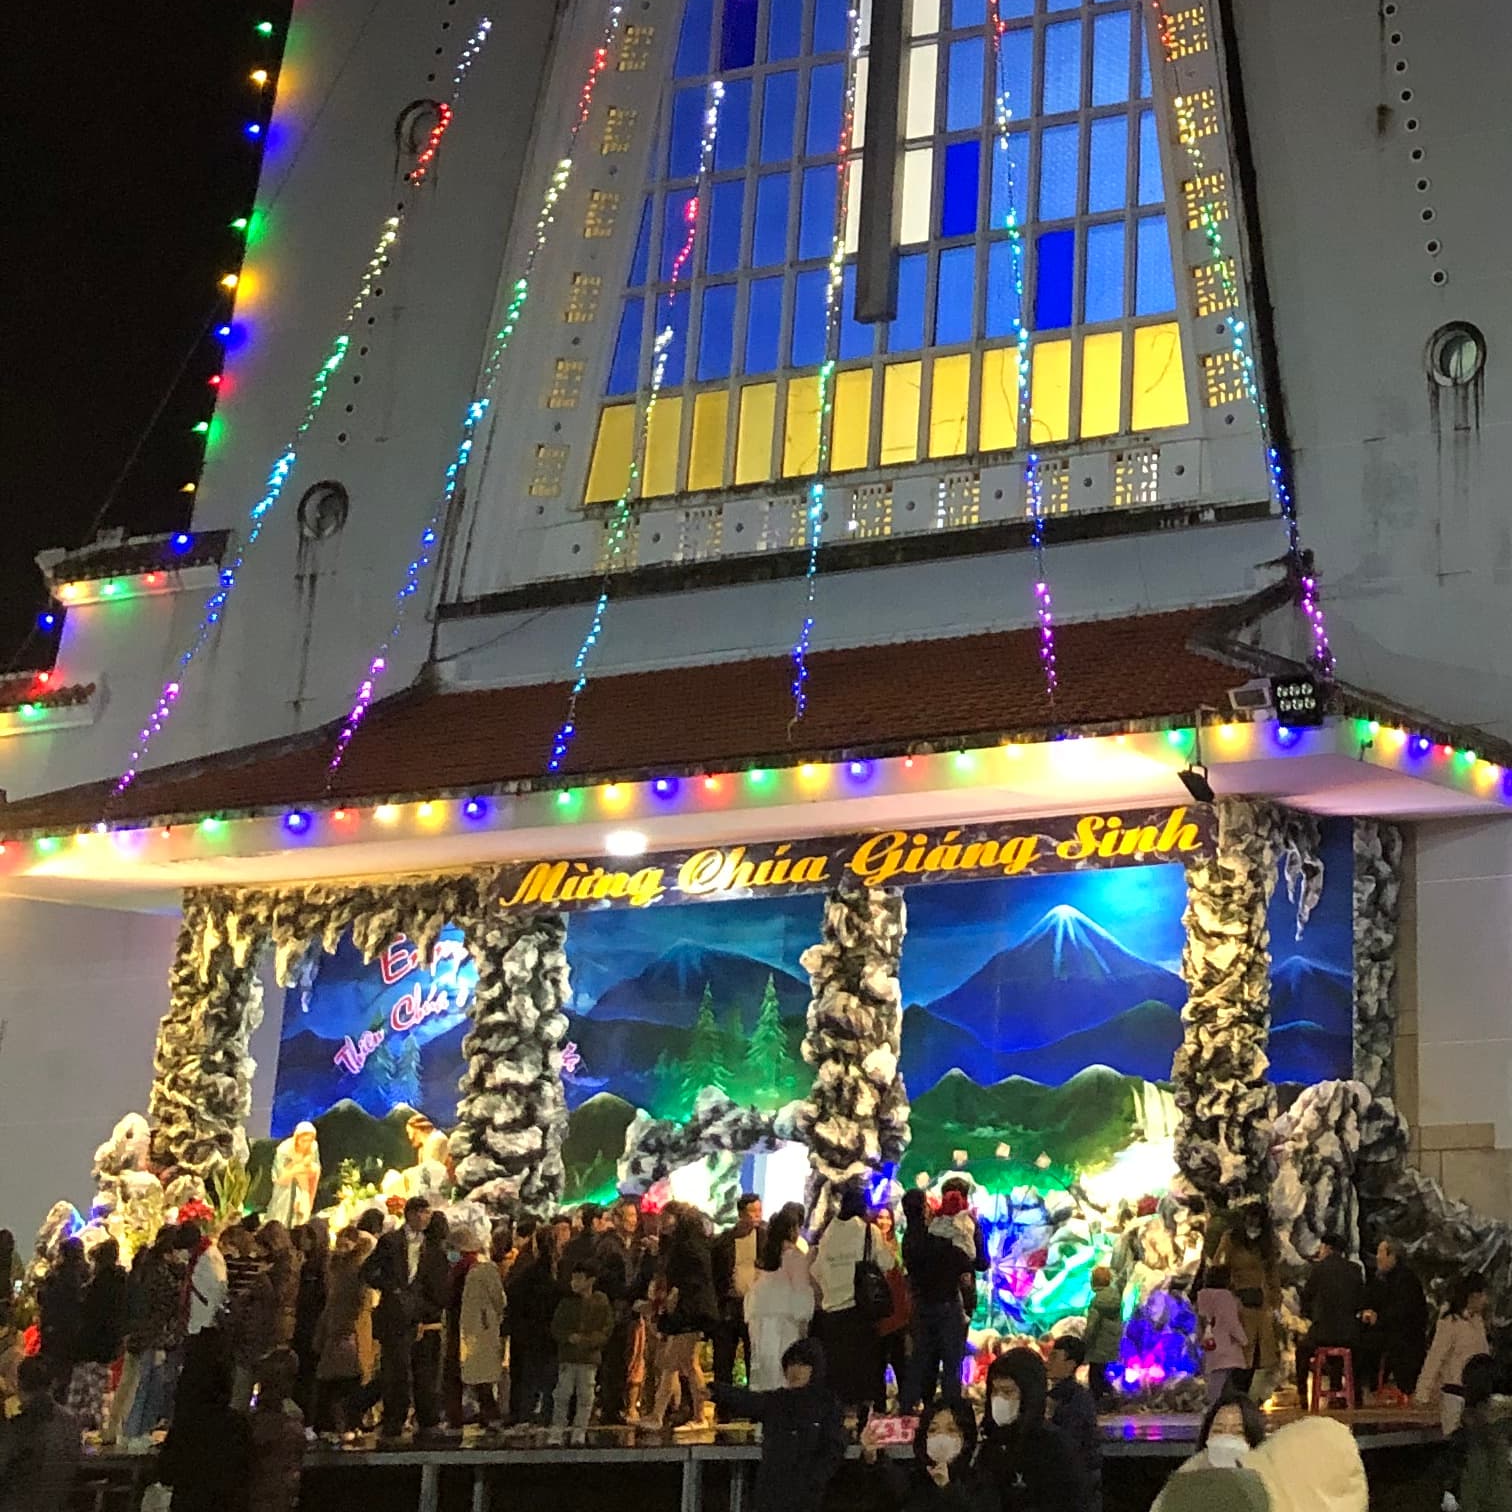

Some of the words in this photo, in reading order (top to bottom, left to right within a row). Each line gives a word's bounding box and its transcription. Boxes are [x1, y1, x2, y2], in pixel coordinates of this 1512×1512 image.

[499, 861, 663, 907] Mừng
[676, 844, 830, 896] Chúa
[844, 828, 1042, 887] Giáng
[1056, 806, 1204, 860] Sinh
